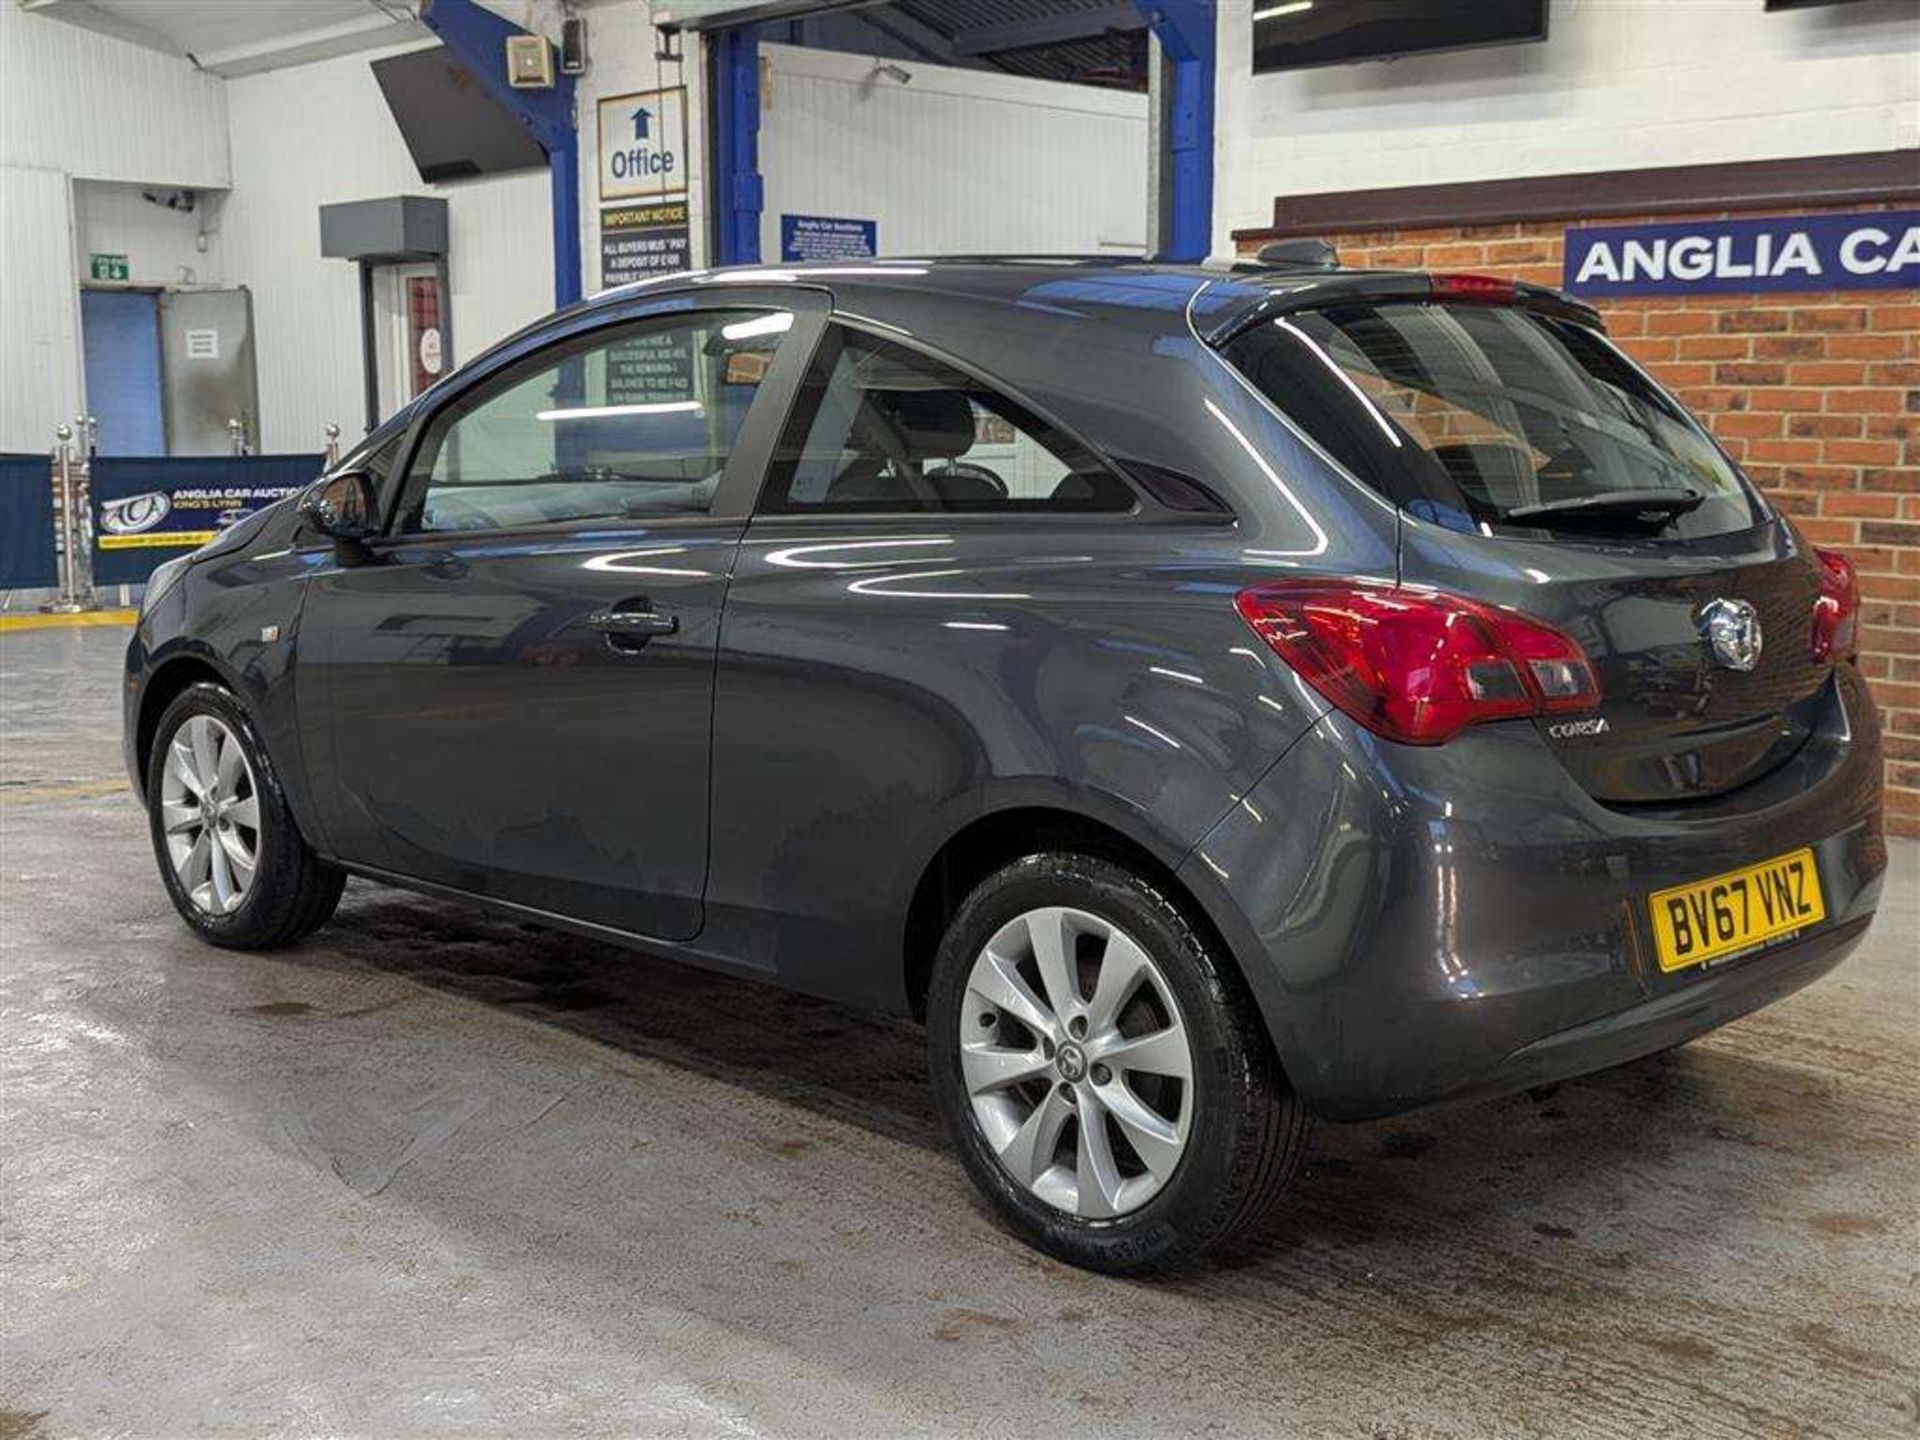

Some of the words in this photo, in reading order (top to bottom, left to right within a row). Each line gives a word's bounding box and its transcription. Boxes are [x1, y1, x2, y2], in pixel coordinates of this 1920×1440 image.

[612, 149, 674, 178] Office
[1575, 233, 1823, 283] ANGLIA
[173, 489, 223, 500] ANGLIA
[224, 488, 252, 499] CAR
[1549, 718, 1610, 739] CORSA
[1667, 880, 1749, 956] BV67
[1757, 863, 1811, 926] VNZ
